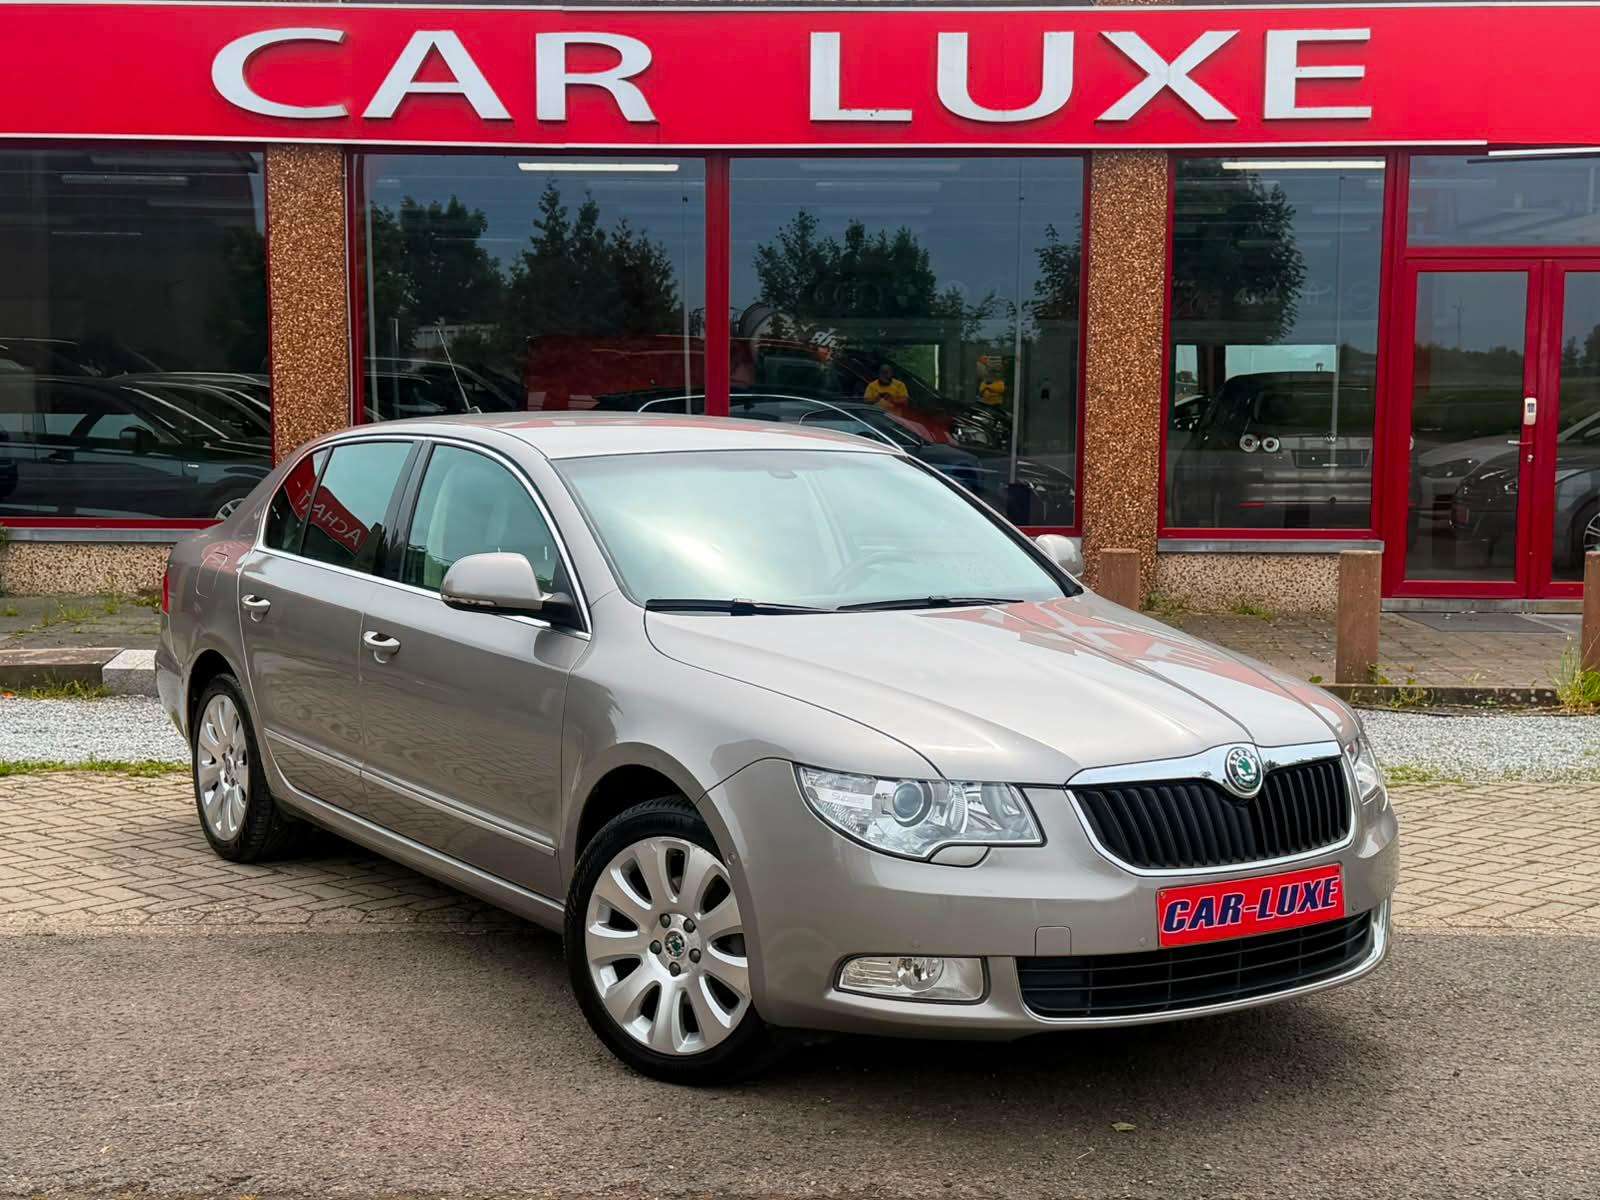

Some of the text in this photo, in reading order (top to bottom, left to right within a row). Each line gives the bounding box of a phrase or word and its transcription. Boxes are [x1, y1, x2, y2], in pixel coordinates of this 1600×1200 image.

[211, 27, 1372, 122] CAR LUXE
[1162, 876, 1339, 933] CAR-LUXE
